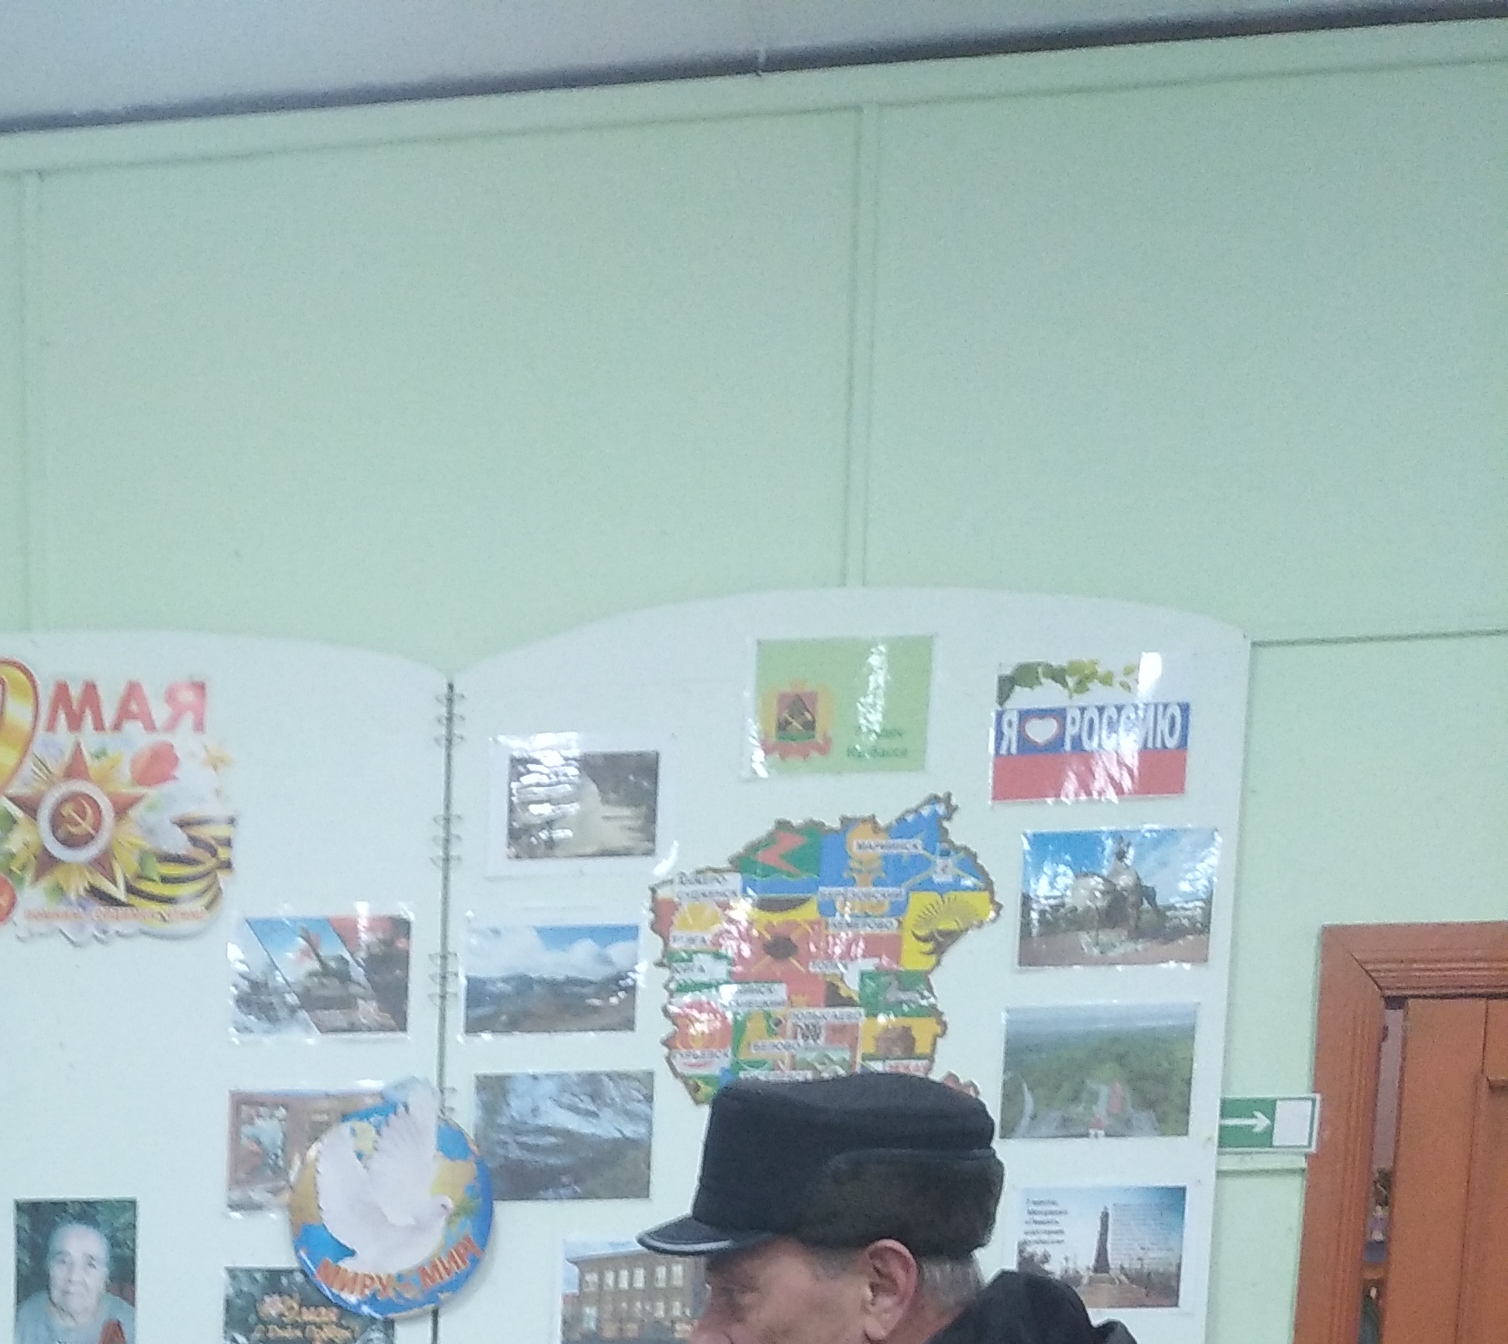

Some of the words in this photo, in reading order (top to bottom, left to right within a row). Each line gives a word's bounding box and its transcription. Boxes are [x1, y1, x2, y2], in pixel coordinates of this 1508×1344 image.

[45, 679, 208, 733] МАЯ
[999, 709, 1018, 755] Я
[1064, 703, 1182, 753] РОССИЮ
